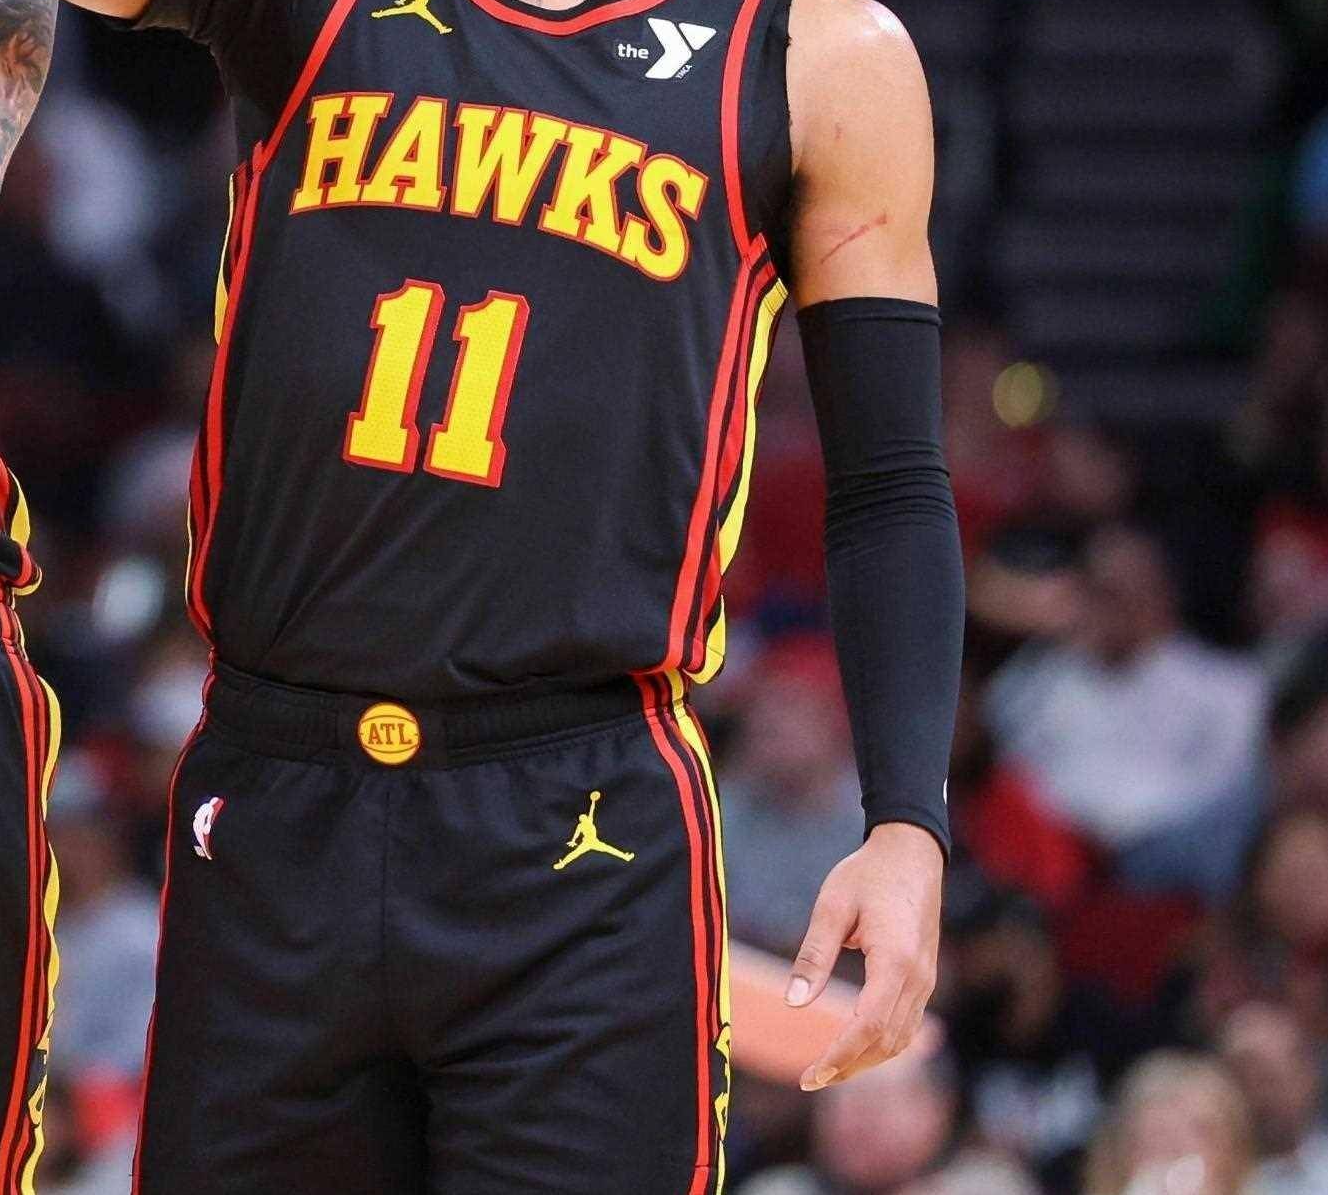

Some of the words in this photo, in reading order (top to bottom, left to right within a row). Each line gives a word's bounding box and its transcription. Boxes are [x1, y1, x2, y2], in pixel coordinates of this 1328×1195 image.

[617, 43, 649, 60] the
[289, 90, 710, 283] HAWKS
[341, 278, 532, 489] 11
[367, 722, 414, 745] ATL
